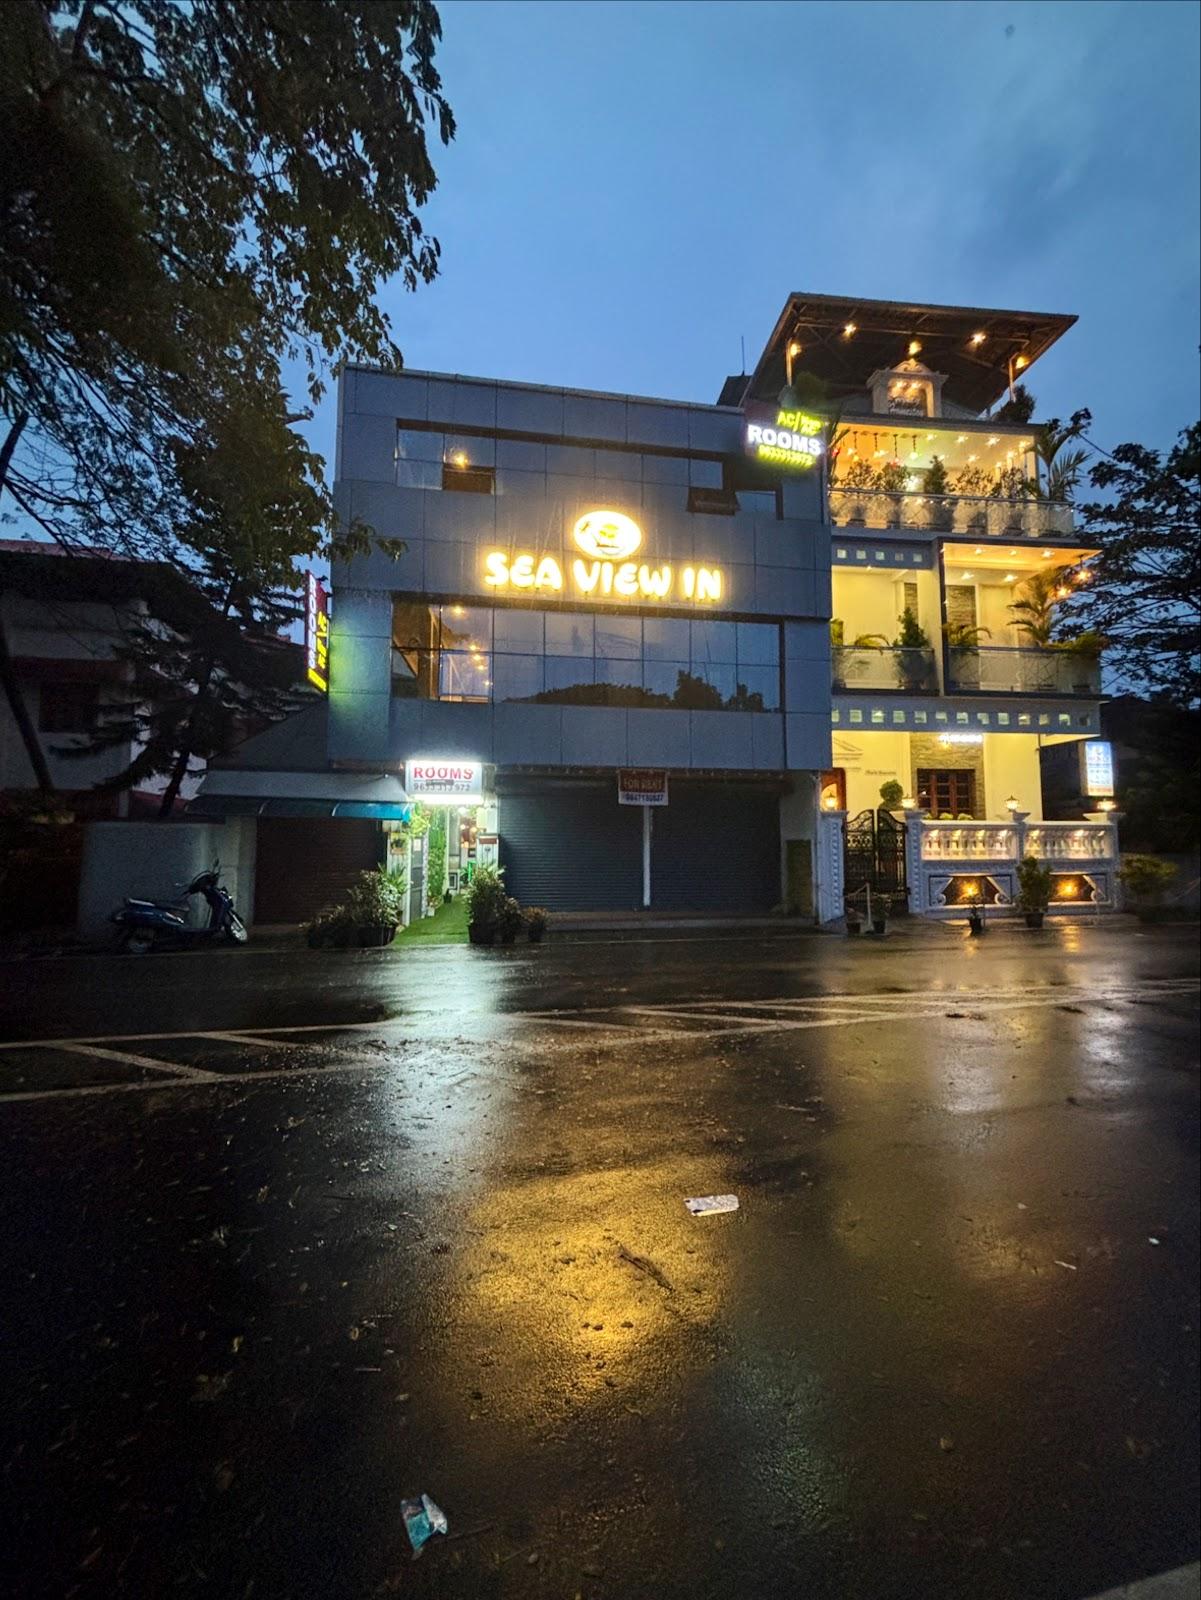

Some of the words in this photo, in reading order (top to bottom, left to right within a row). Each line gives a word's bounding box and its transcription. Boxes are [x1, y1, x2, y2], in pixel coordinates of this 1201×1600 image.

[747, 424, 821, 457] ROOMS
[485, 551, 563, 591] SEA
[573, 558, 671, 598] VIEW
[683, 566, 722, 600] IN
[413, 766, 474, 780] ROOMS
